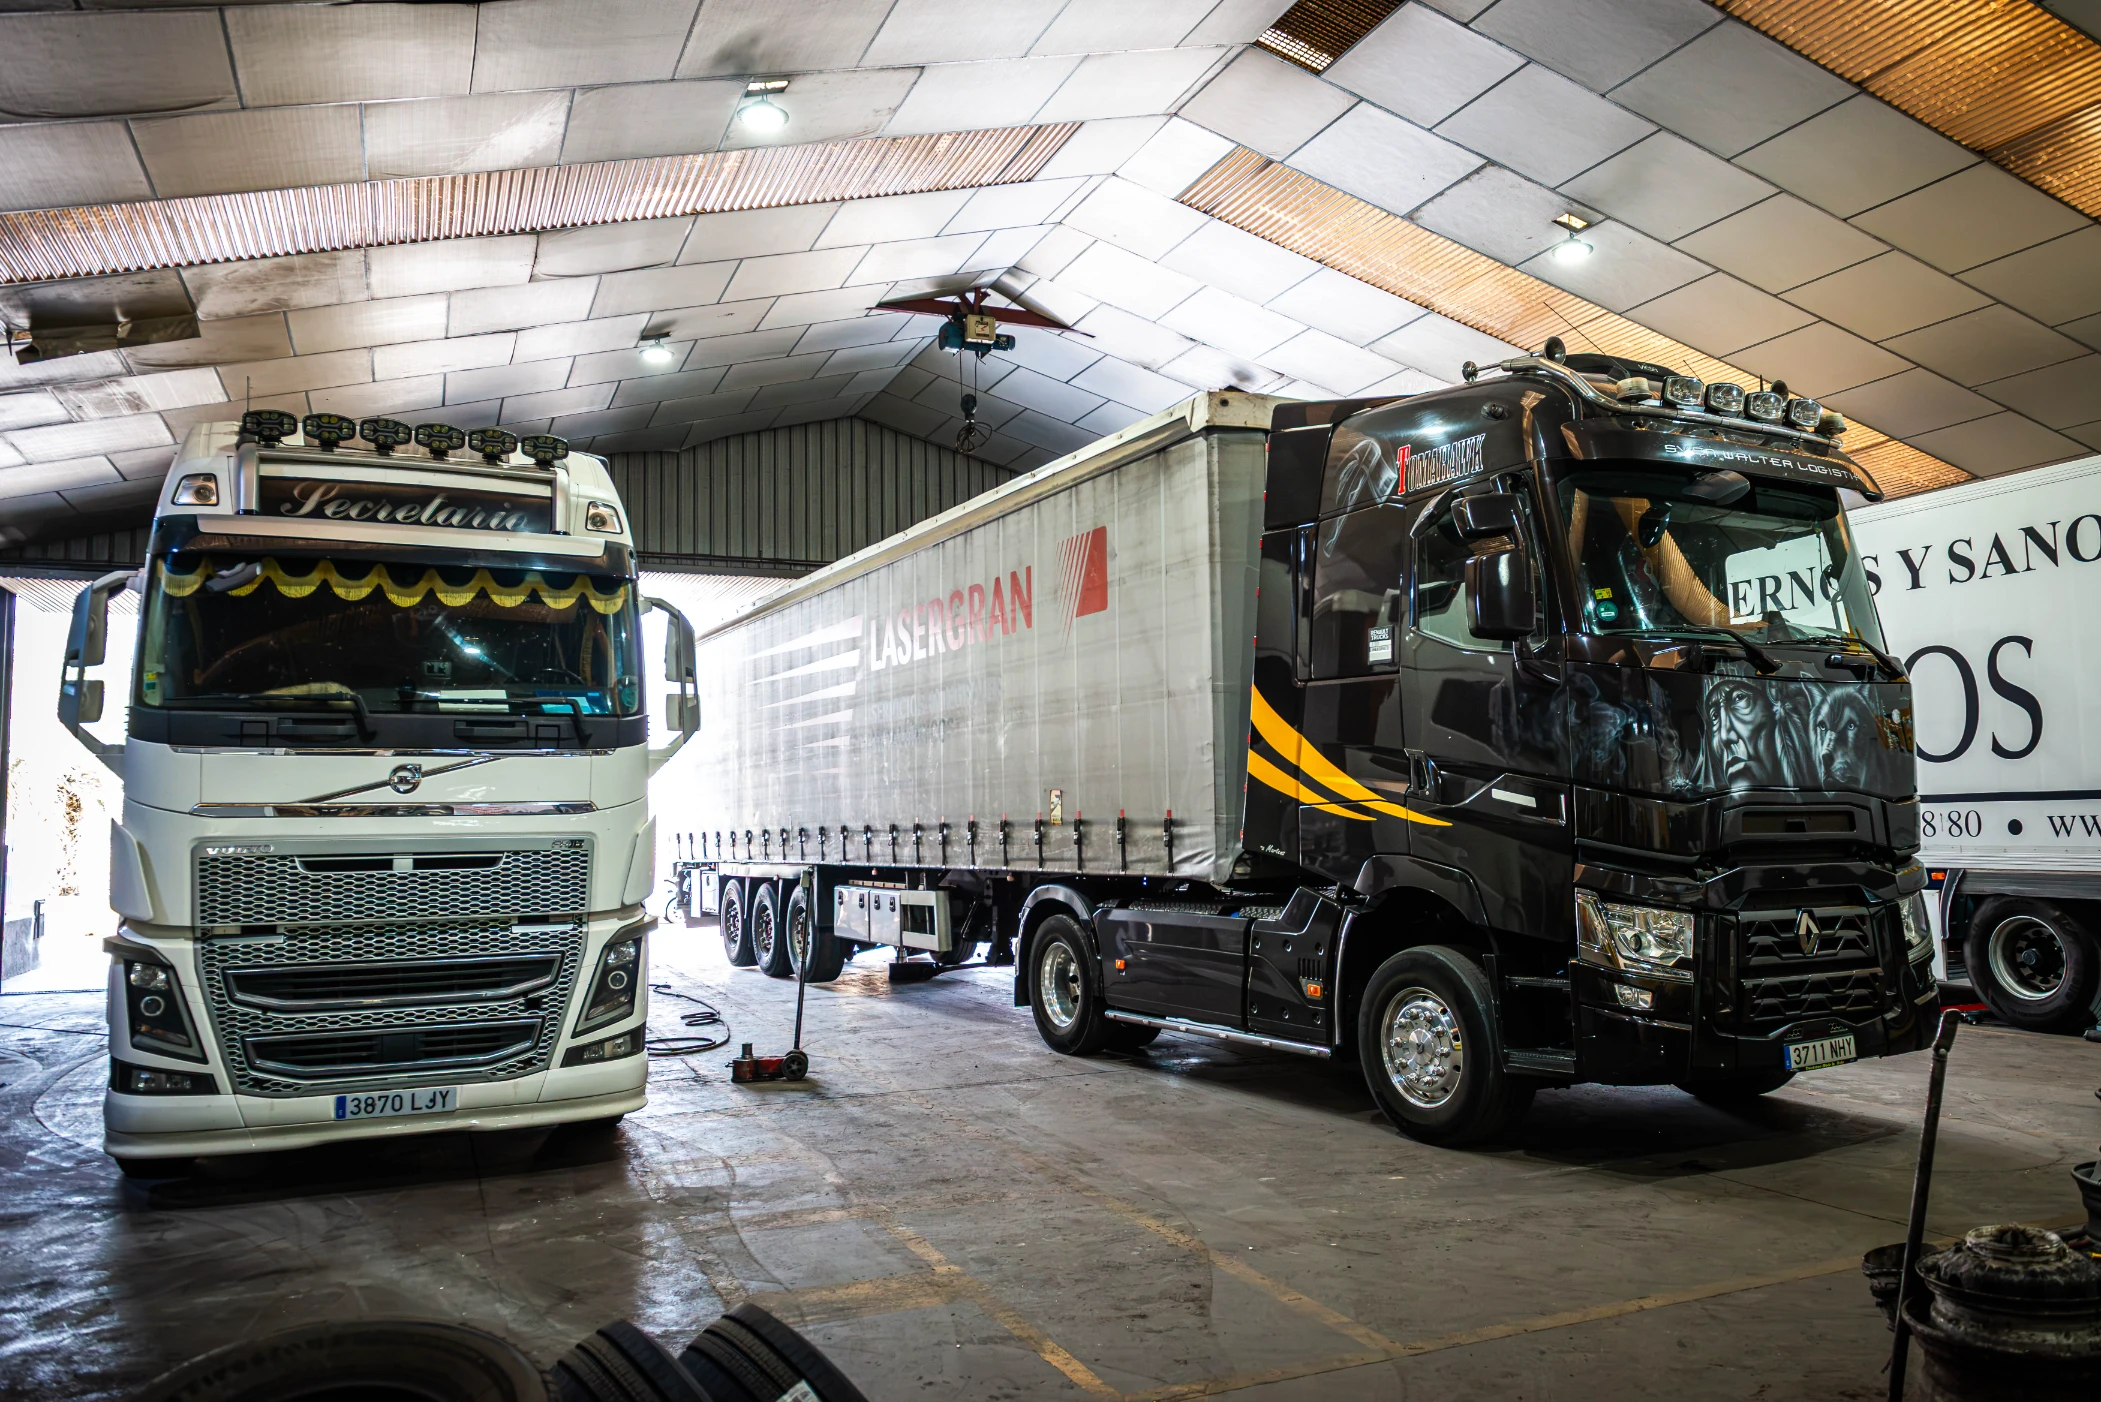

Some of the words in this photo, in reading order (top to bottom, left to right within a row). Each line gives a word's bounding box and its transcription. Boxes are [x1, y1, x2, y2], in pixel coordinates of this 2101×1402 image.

[1723, 451, 1794, 468] WALTER
[280, 481, 529, 532] Secretario
[1895, 545, 1933, 591] Y
[870, 565, 1033, 672] LASERGRAN
[1794, 1042, 1826, 1066] 3711
[1830, 1037, 1852, 1059] NHY
[350, 1095, 404, 1116] 3870
[411, 1090, 450, 1111] LJY
